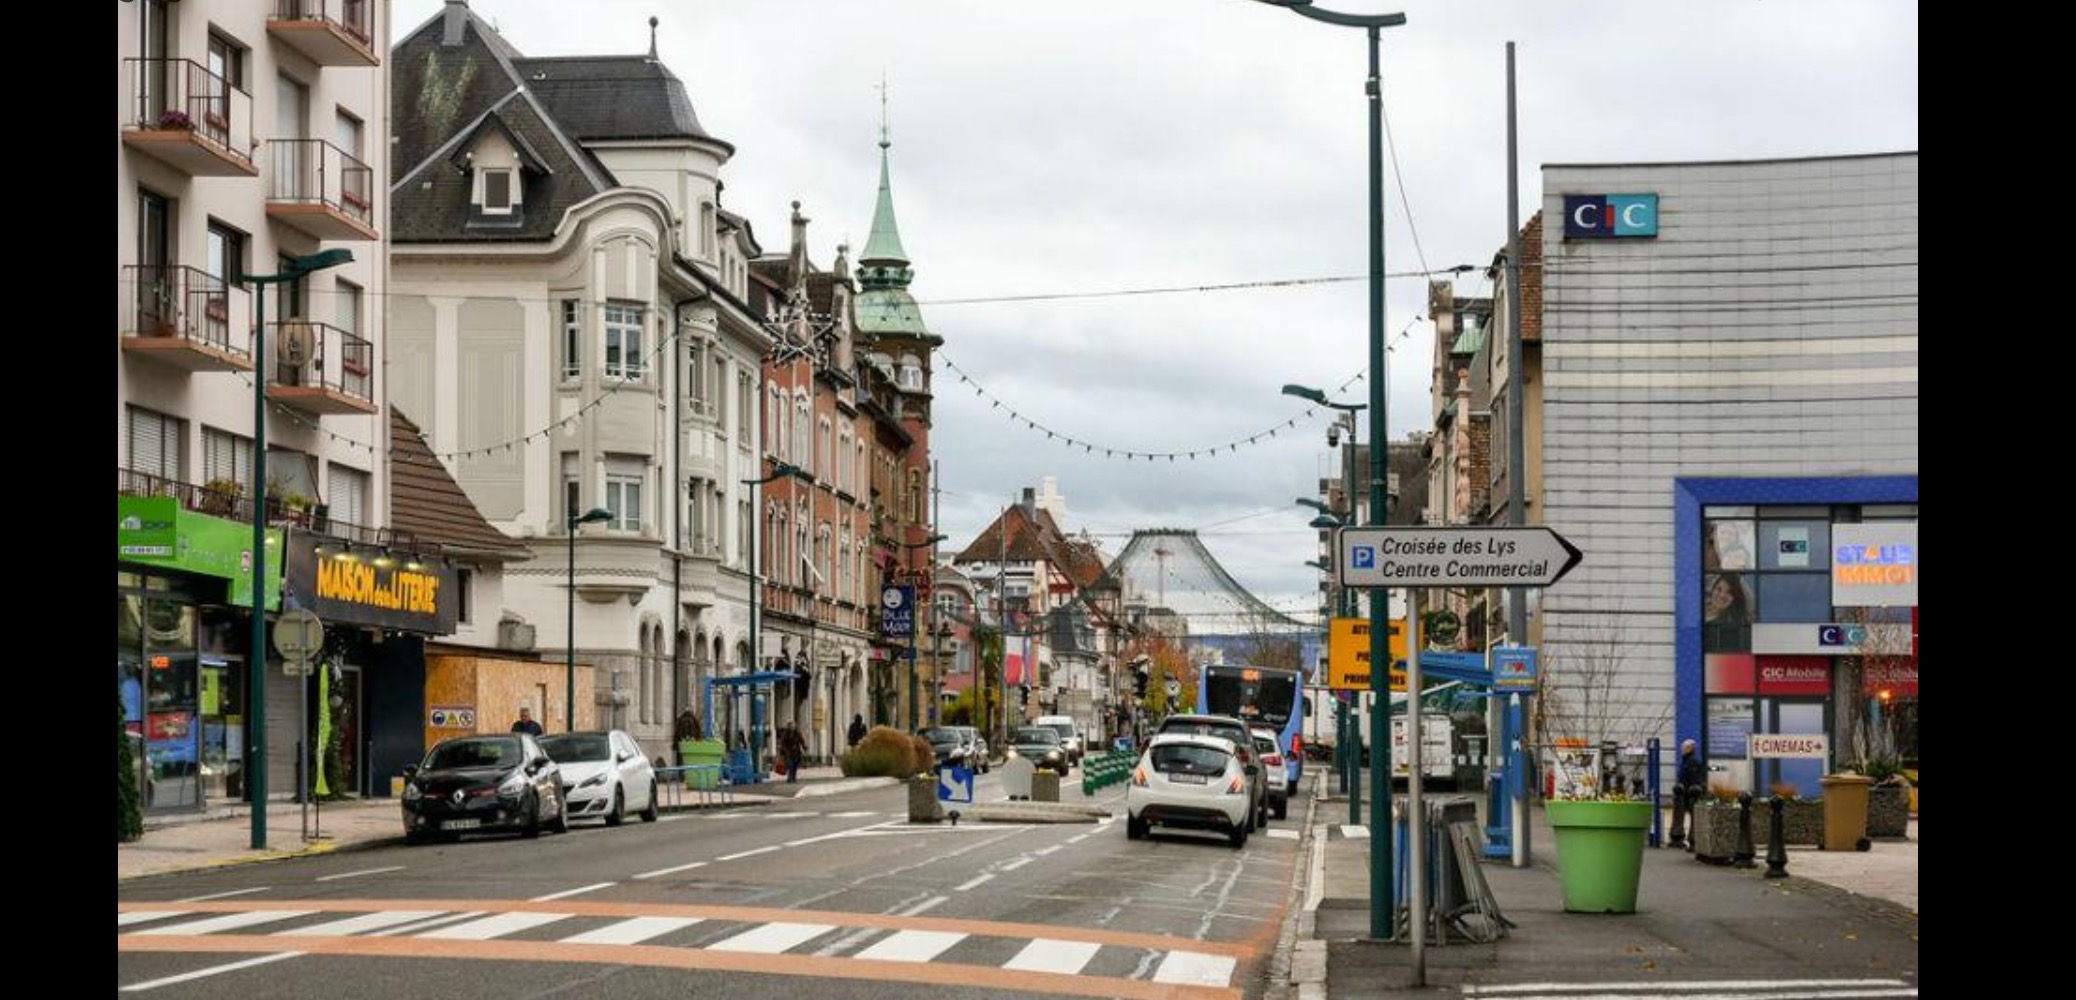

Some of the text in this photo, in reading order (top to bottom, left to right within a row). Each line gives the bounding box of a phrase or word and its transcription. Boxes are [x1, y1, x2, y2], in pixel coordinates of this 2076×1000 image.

[1572, 201, 1649, 230] CIC
[1382, 537, 1516, 558] Croisée des Lys
[1383, 560, 1548, 577] Centre Commercial
[317, 557, 374, 604] MAISON
[392, 570, 436, 614] LITERIE
[1822, 628, 1862, 643] CIC
[1762, 667, 1826, 679] CIC Mobile
[1761, 739, 1813, 753] CINEMAS
